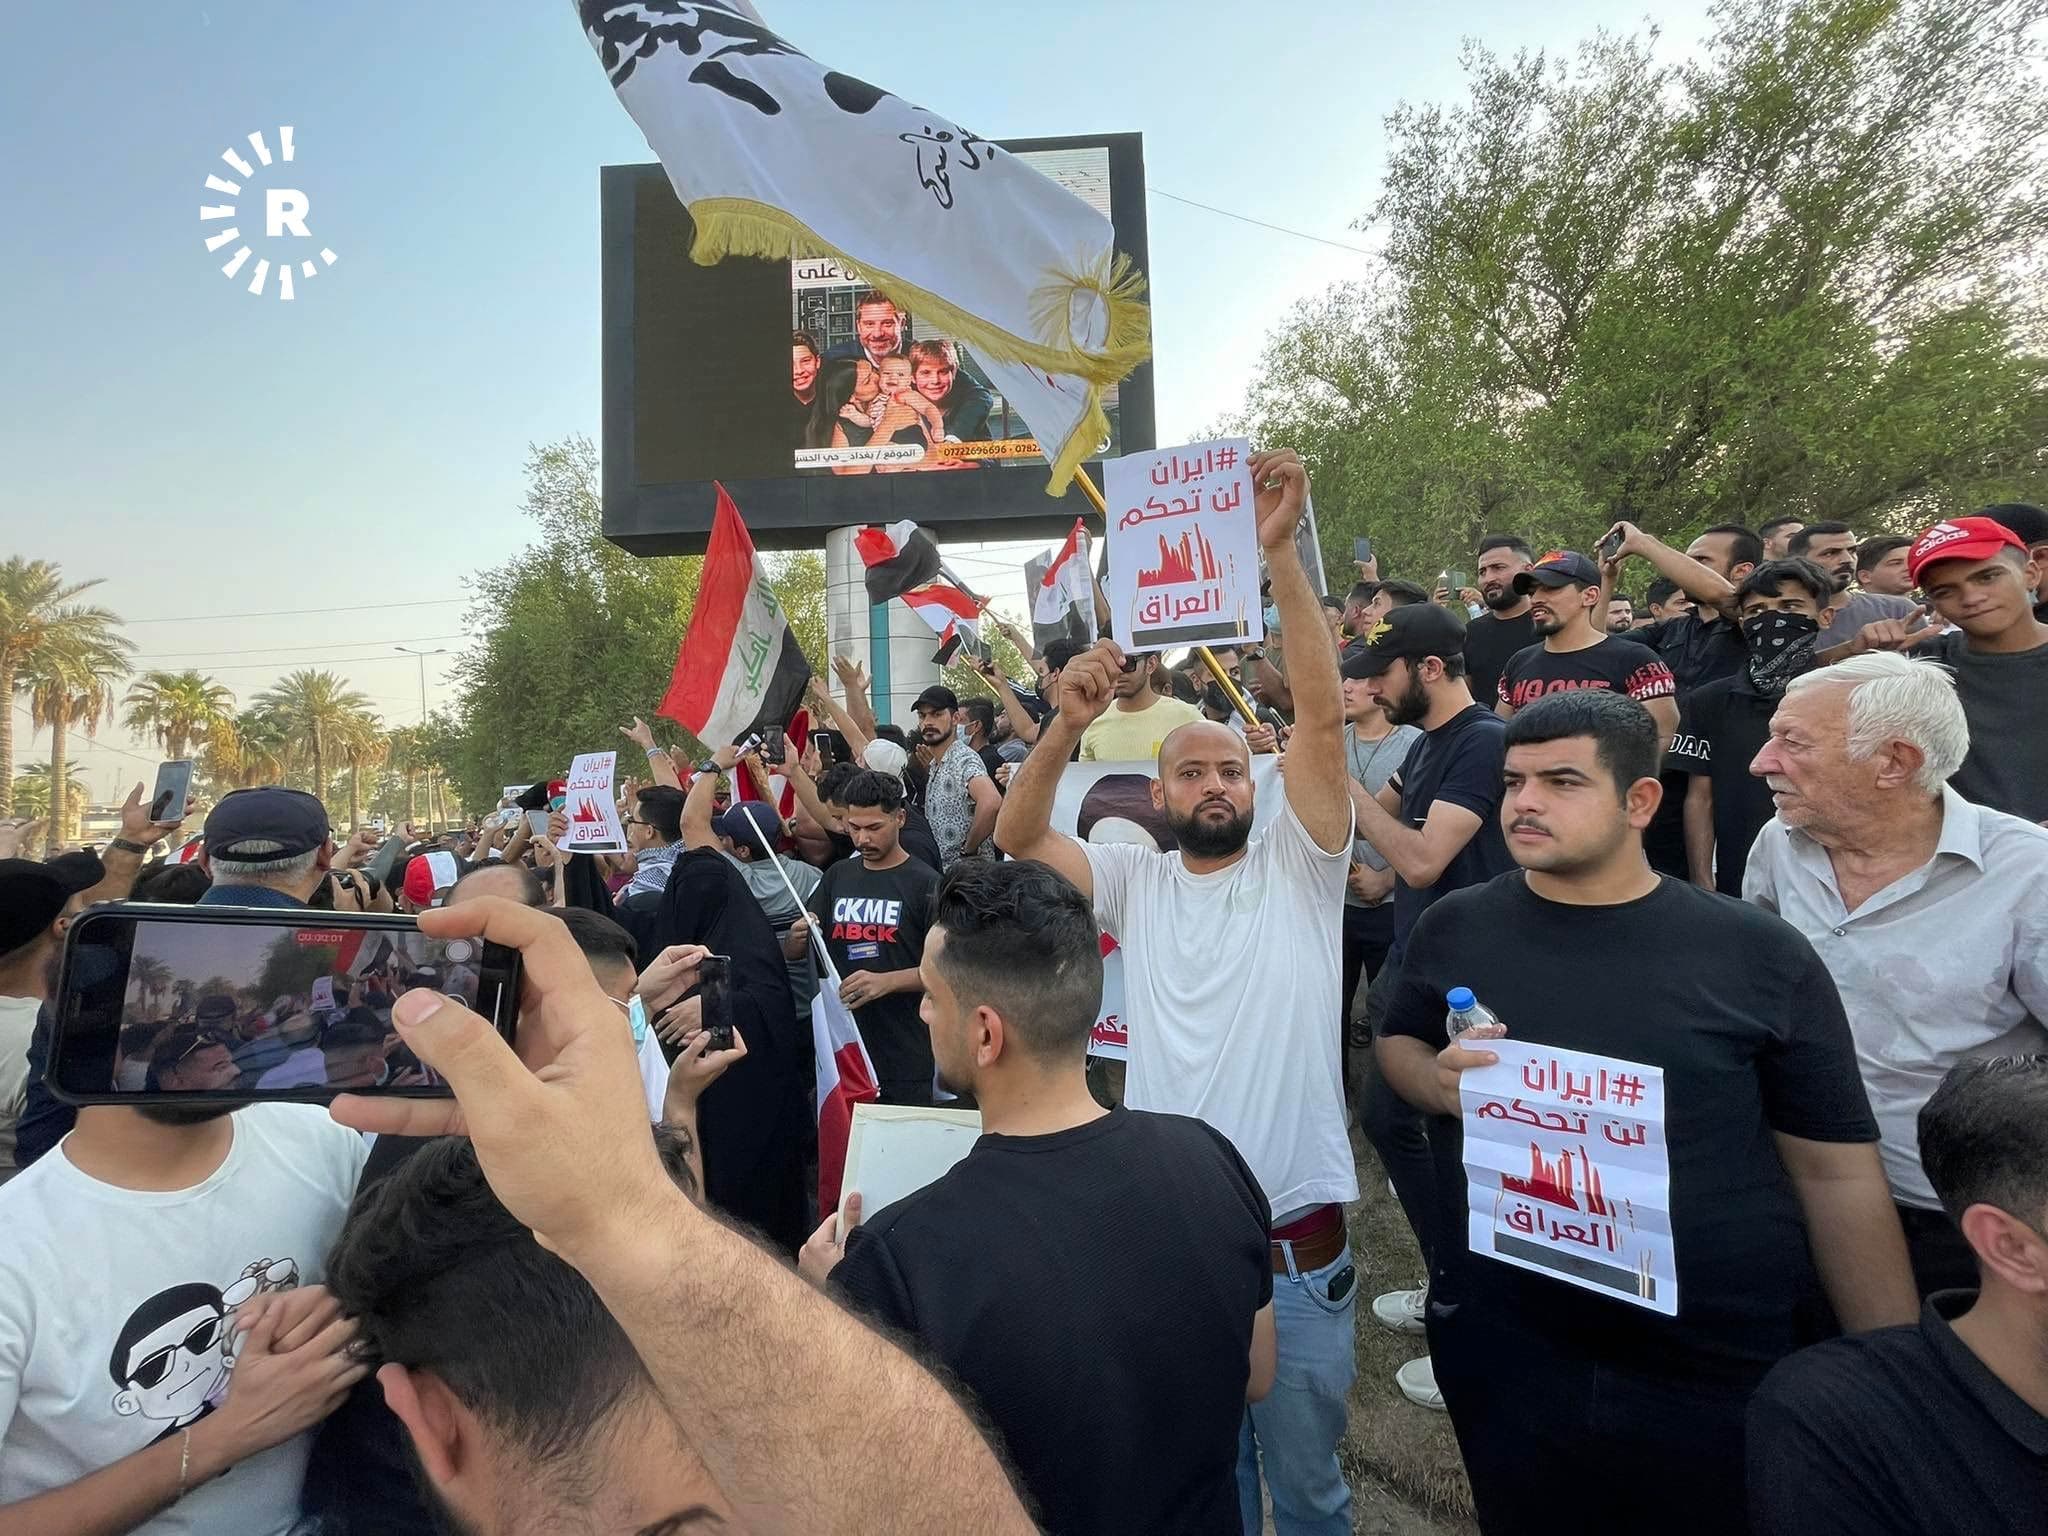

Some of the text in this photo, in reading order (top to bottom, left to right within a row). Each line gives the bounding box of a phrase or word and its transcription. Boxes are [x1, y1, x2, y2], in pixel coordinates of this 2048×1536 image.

[883, 449, 916, 461] الموقع
[1150, 447, 1239, 485] #ايران
[1117, 482, 1241, 531] لن تحكم
[1915, 529, 1970, 557] adidas
[1138, 589, 1222, 625] العراق
[583, 757, 611, 773] #ايران
[570, 776, 609, 790] لن تحكم
[576, 825, 609, 840] العراق
[834, 898, 900, 925] CKME
[831, 923, 897, 943] ABCK
[1522, 1057, 1646, 1107] #ايران
[1476, 1098, 1646, 1147] لن تحكم
[1505, 1202, 1615, 1252] العراق
